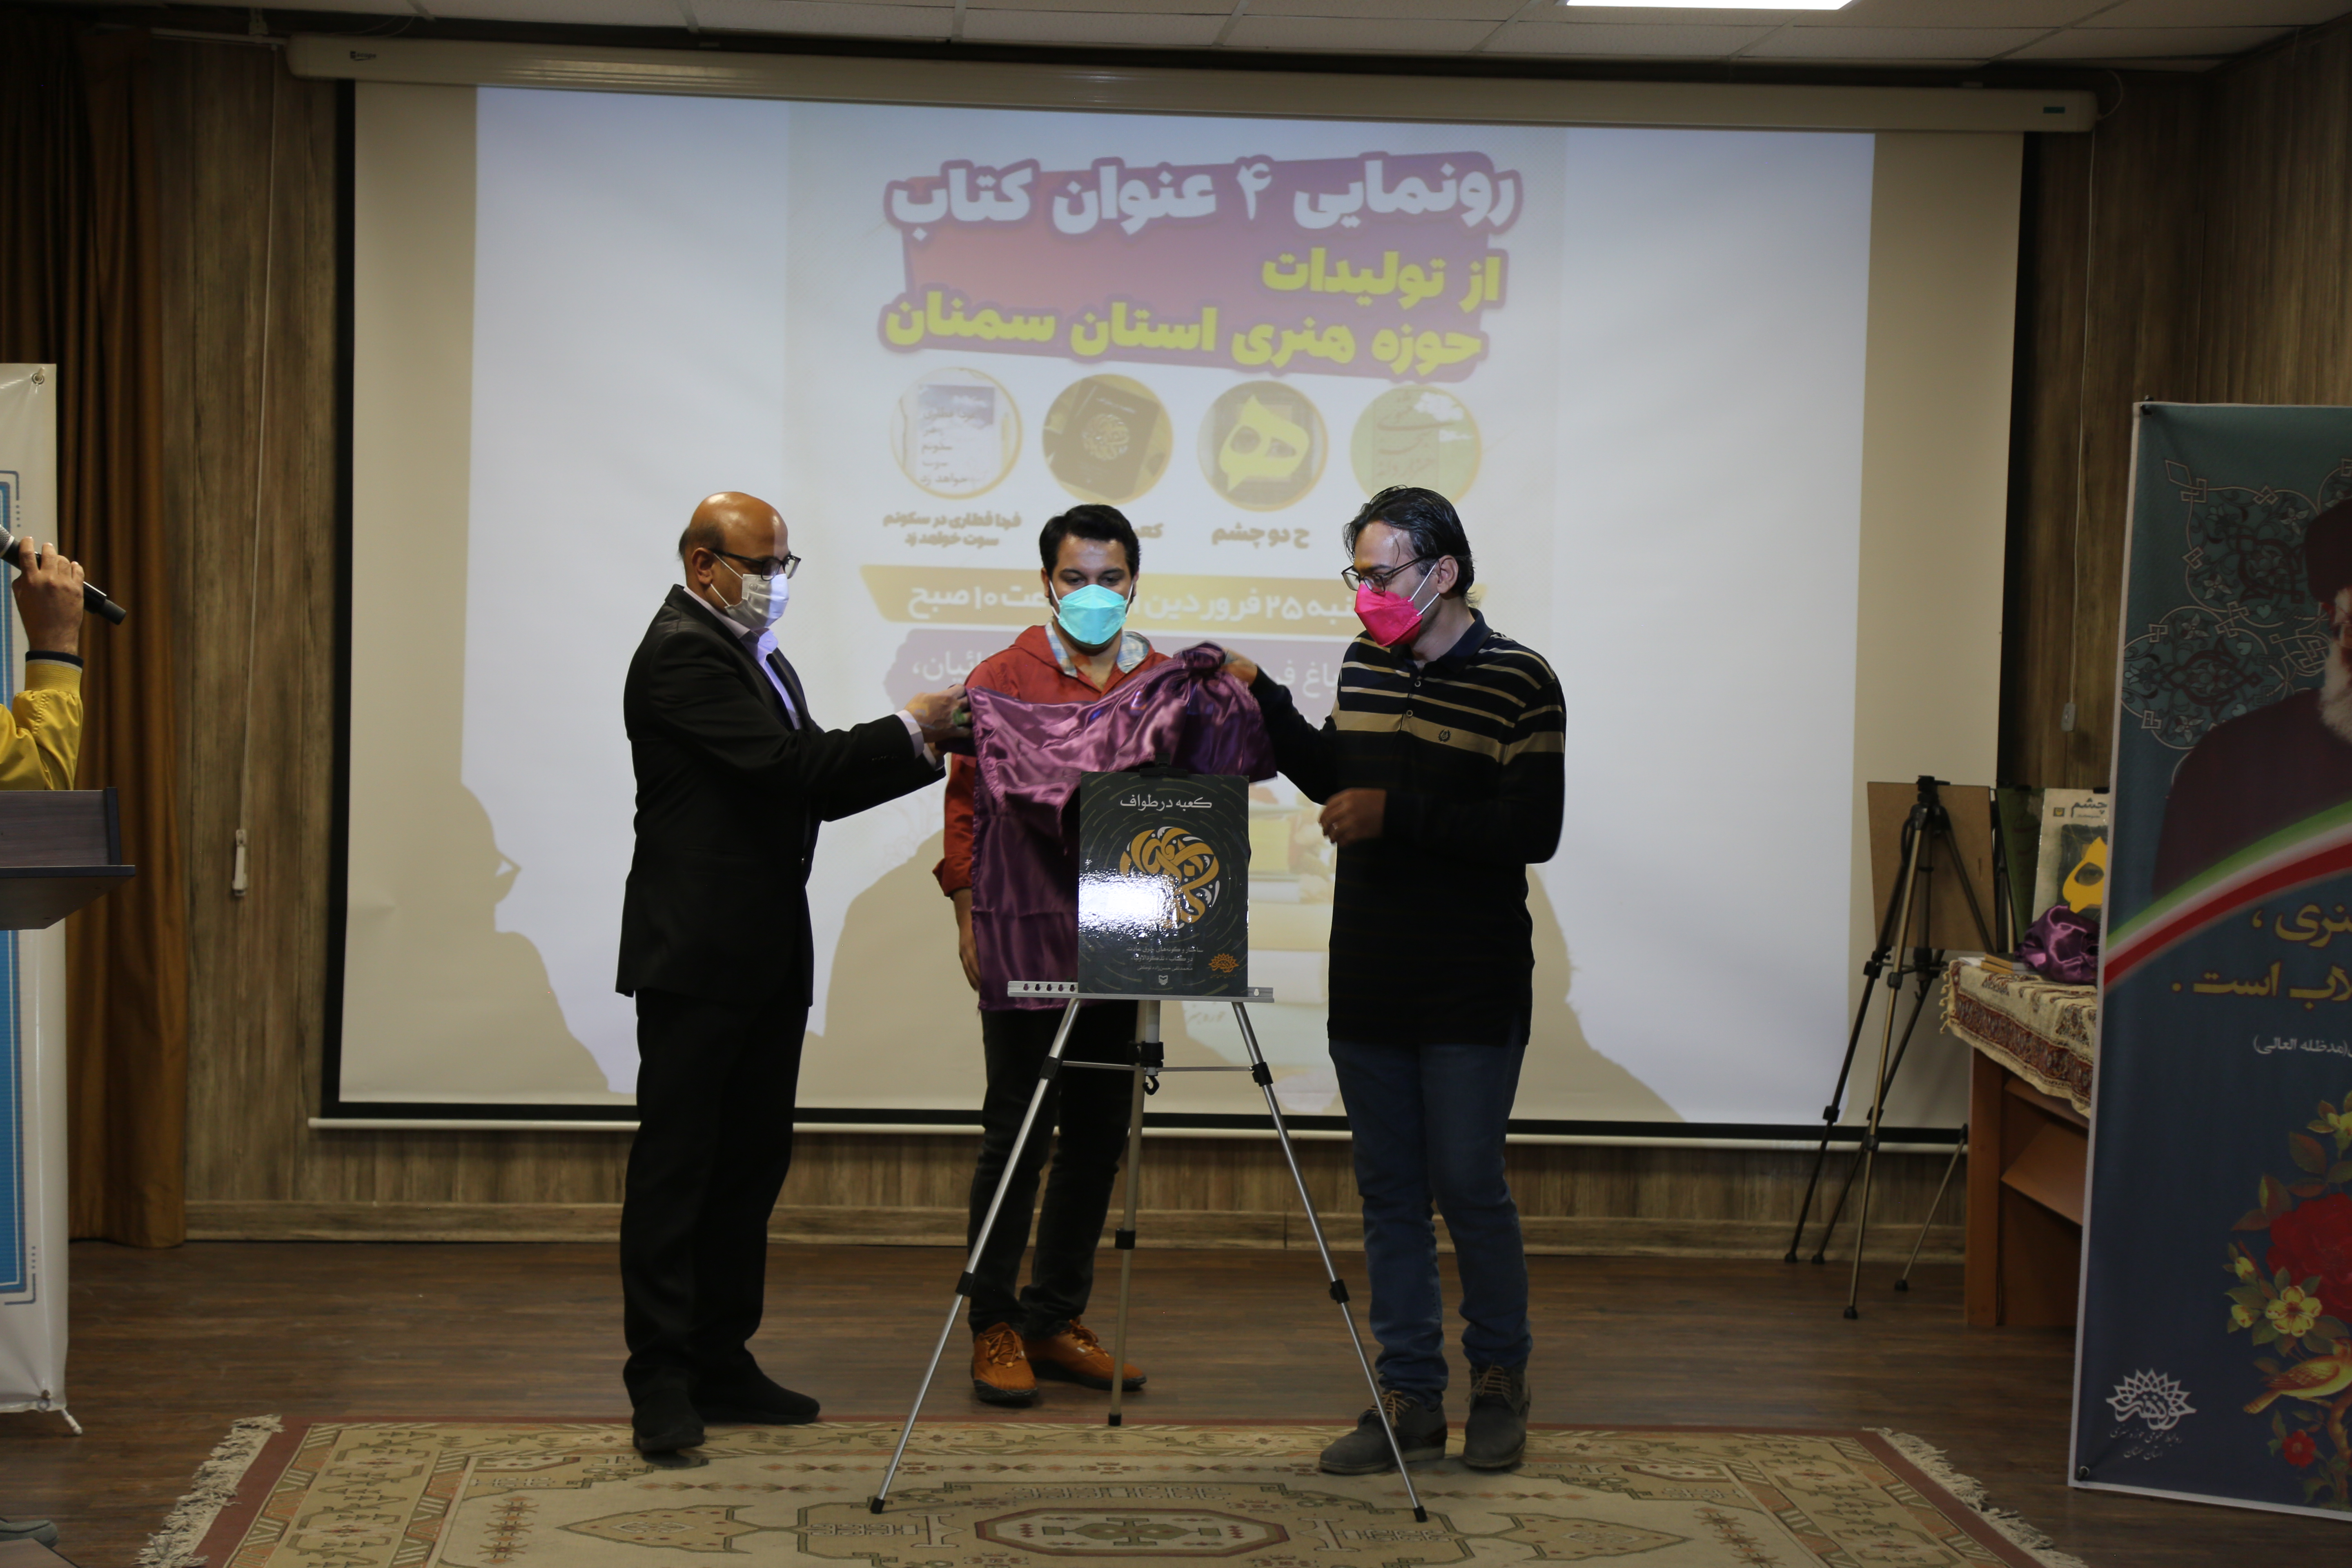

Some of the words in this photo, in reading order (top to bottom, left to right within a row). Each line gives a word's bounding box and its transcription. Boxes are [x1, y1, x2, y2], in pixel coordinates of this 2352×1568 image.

[891, 165, 1032, 241] کتاب
[1051, 165, 1217, 235] عنوان
[1235, 163, 1273, 220] ۴
[1293, 158, 1514, 230] رونمایی
[1261, 247, 1446, 310] تولیدات
[1459, 256, 1502, 312] از
[884, 290, 1055, 345] سمنان
[1070, 301, 1218, 356] استان
[1231, 317, 1356, 367] هنری
[1371, 321, 1483, 374] حوزه
[1211, 521, 1265, 549] چشم
[907, 587, 970, 619] صبح
[1145, 587, 1261, 622] فروردین
[1266, 595, 1303, 621] ۲۵
[1120, 794, 1157, 811] طواف
[1156, 800, 1173, 811] در
[1176, 796, 1212, 812] کعبه
[2071, 797, 2108, 818] چشم
[2193, 961, 2281, 996] است
